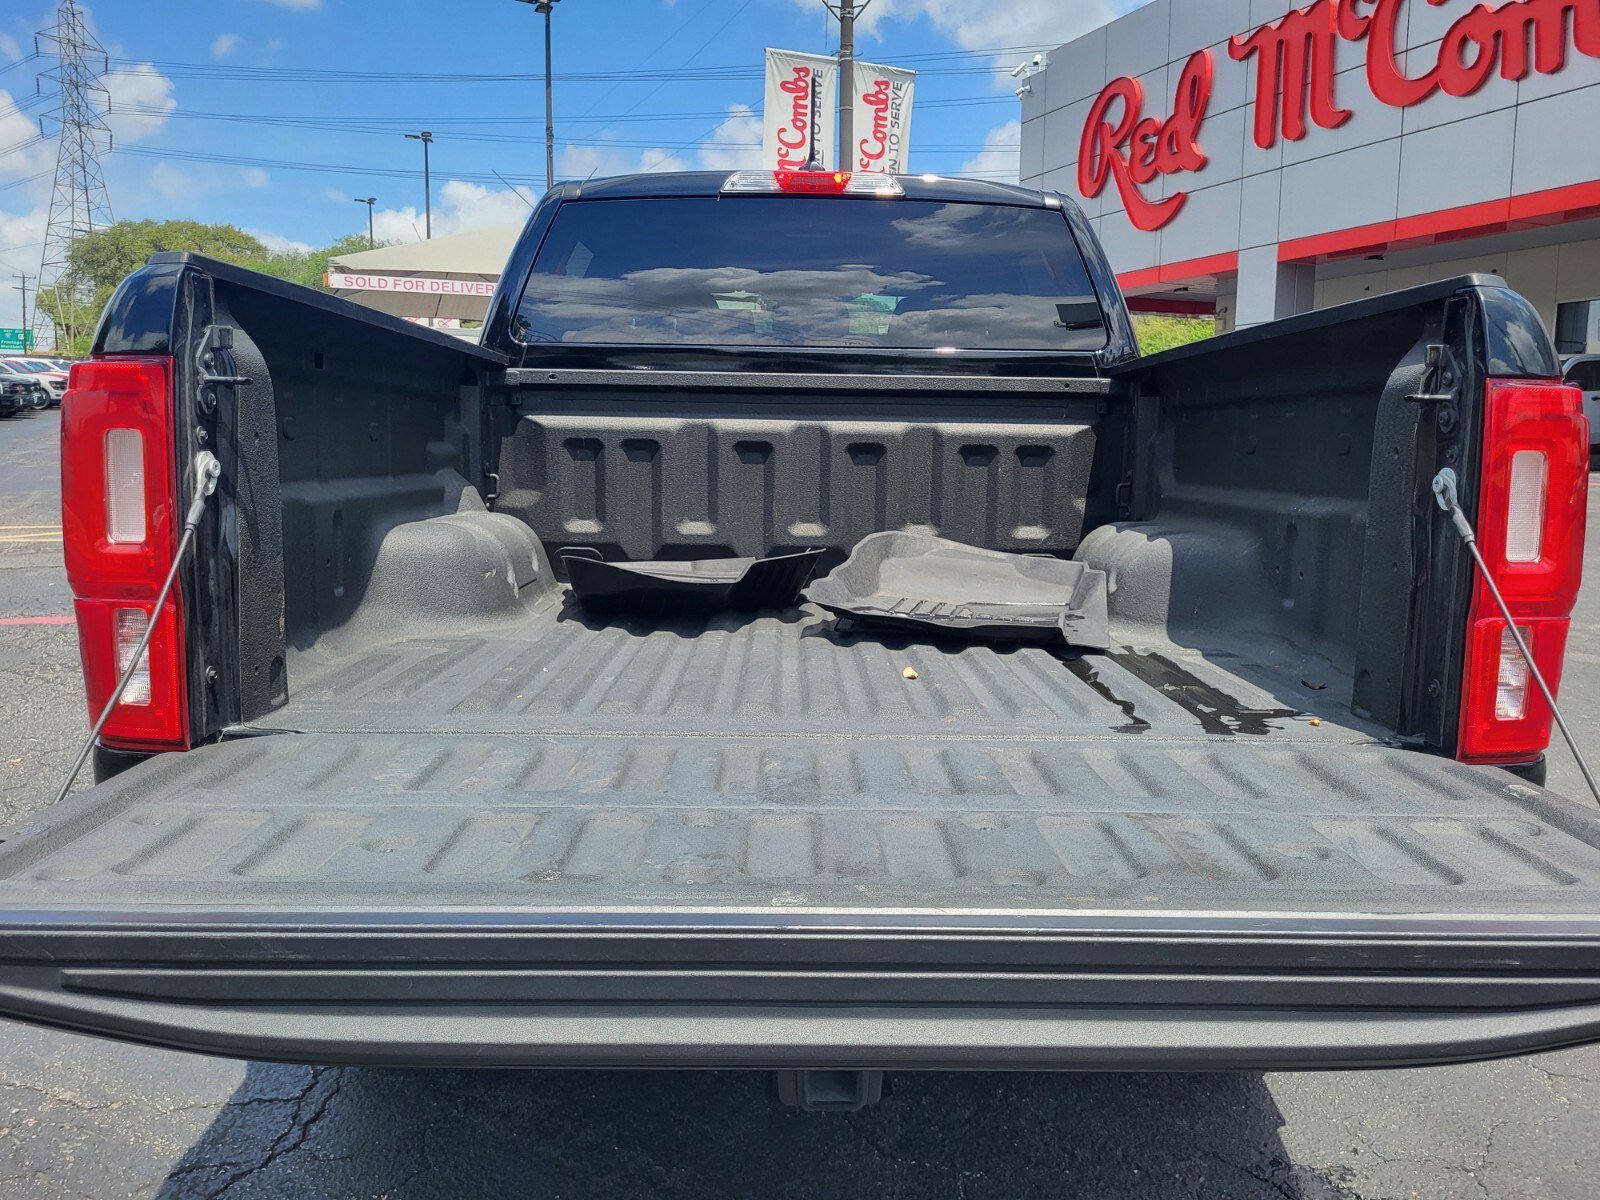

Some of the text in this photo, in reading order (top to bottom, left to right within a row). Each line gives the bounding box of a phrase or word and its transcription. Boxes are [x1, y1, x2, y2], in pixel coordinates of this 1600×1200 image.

[812, 68, 823, 119] SERVE
[890, 81, 903, 129] SERVE
[859, 80, 890, 173] cCombs
[889, 133, 900, 155] TO
[1077, 49, 1213, 231] Red
[344, 276, 388, 289] SOLD
[394, 279, 426, 291] FOR
